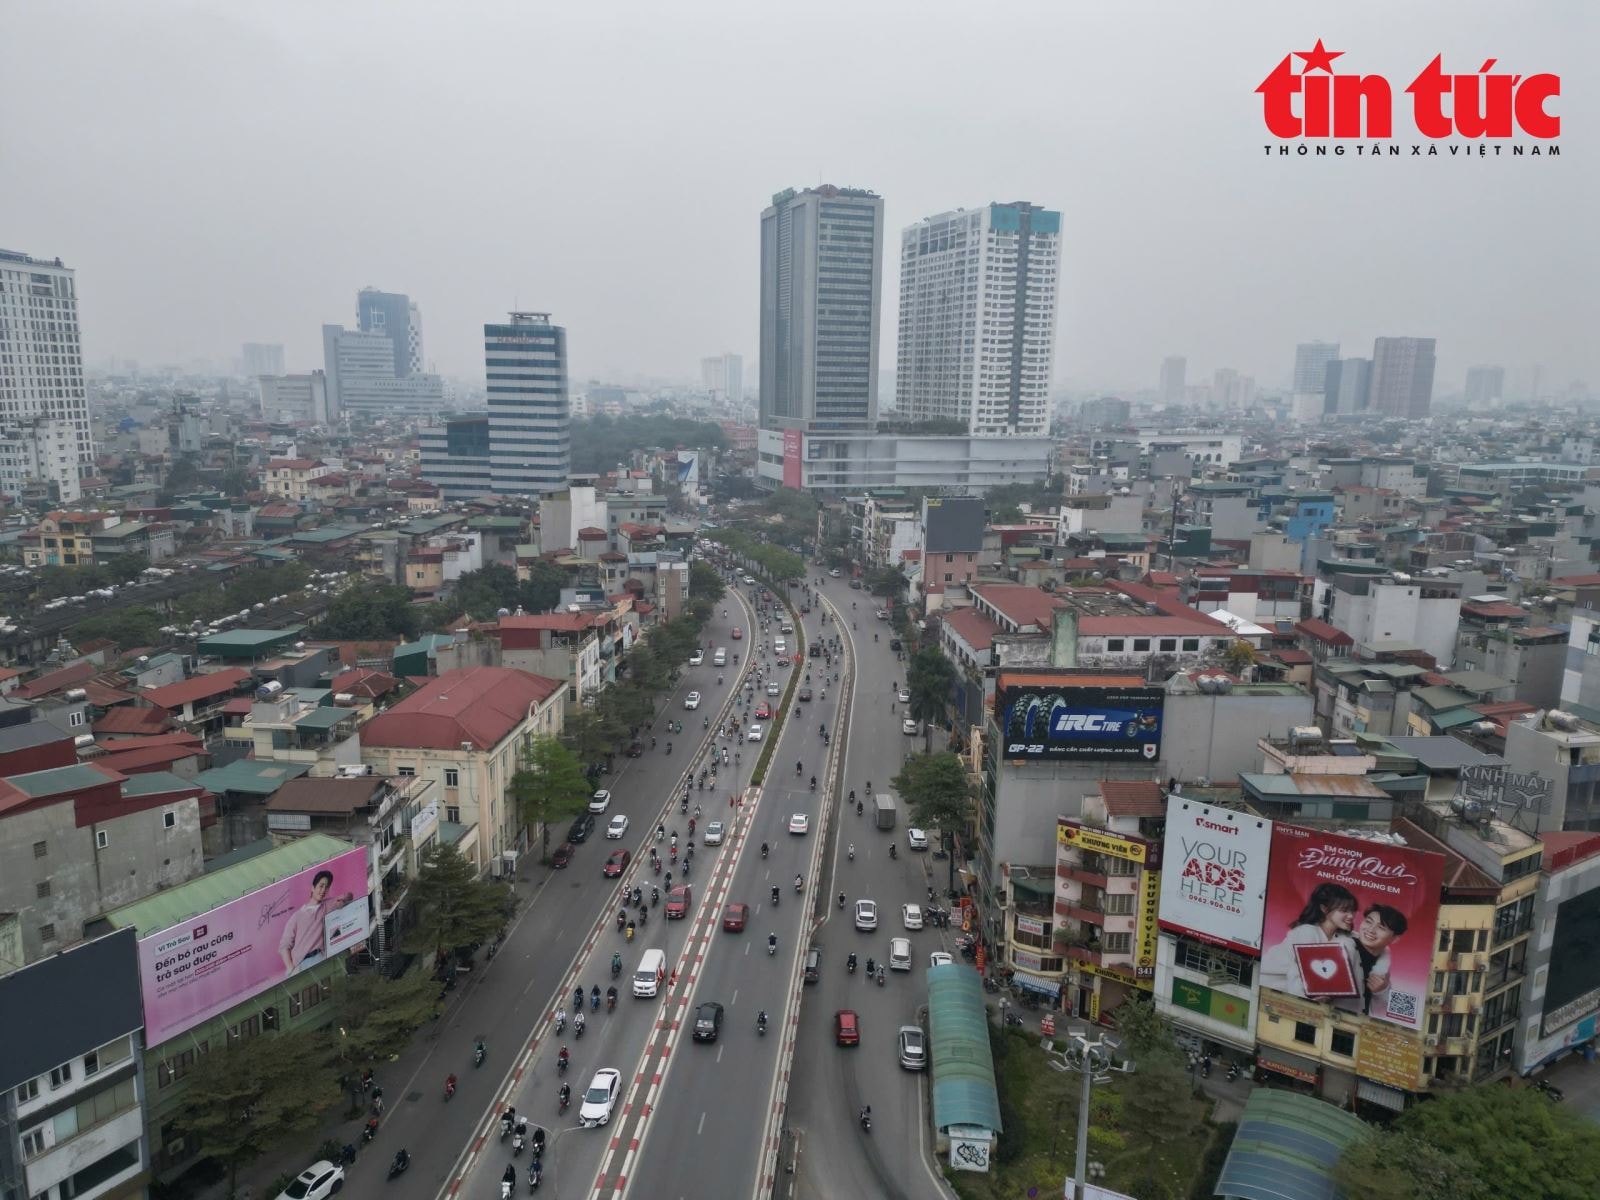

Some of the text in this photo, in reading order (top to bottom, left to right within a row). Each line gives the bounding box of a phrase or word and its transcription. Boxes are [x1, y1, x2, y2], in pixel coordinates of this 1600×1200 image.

[1101, 721, 1123, 732] TIRE
[1009, 743, 1044, 753] GP-22
[1461, 780, 1546, 809] LILY
[1295, 829, 1310, 838] MAN
[1181, 836, 1247, 870] YOUR
[1323, 844, 1363, 858] EM CHỌN
[1182, 858, 1246, 892] ADS
[1297, 847, 1418, 885] Đúng Quà
[1181, 877, 1243, 905] HERE
[1316, 870, 1335, 880] ANH
[1335, 874, 1361, 886] CHỌN
[1386, 885, 1401, 894] EM
[1188, 894, 1241, 914] 0962.906.086
[178, 935, 191, 943] Sau
[155, 956, 176, 972] Đến
[192, 943, 209, 955] rau
[210, 931, 234, 947] cũng
[156, 969, 172, 983] trả
[173, 963, 191, 975] sau
[193, 950, 218, 967] được
[1137, 967, 1153, 975] 341
